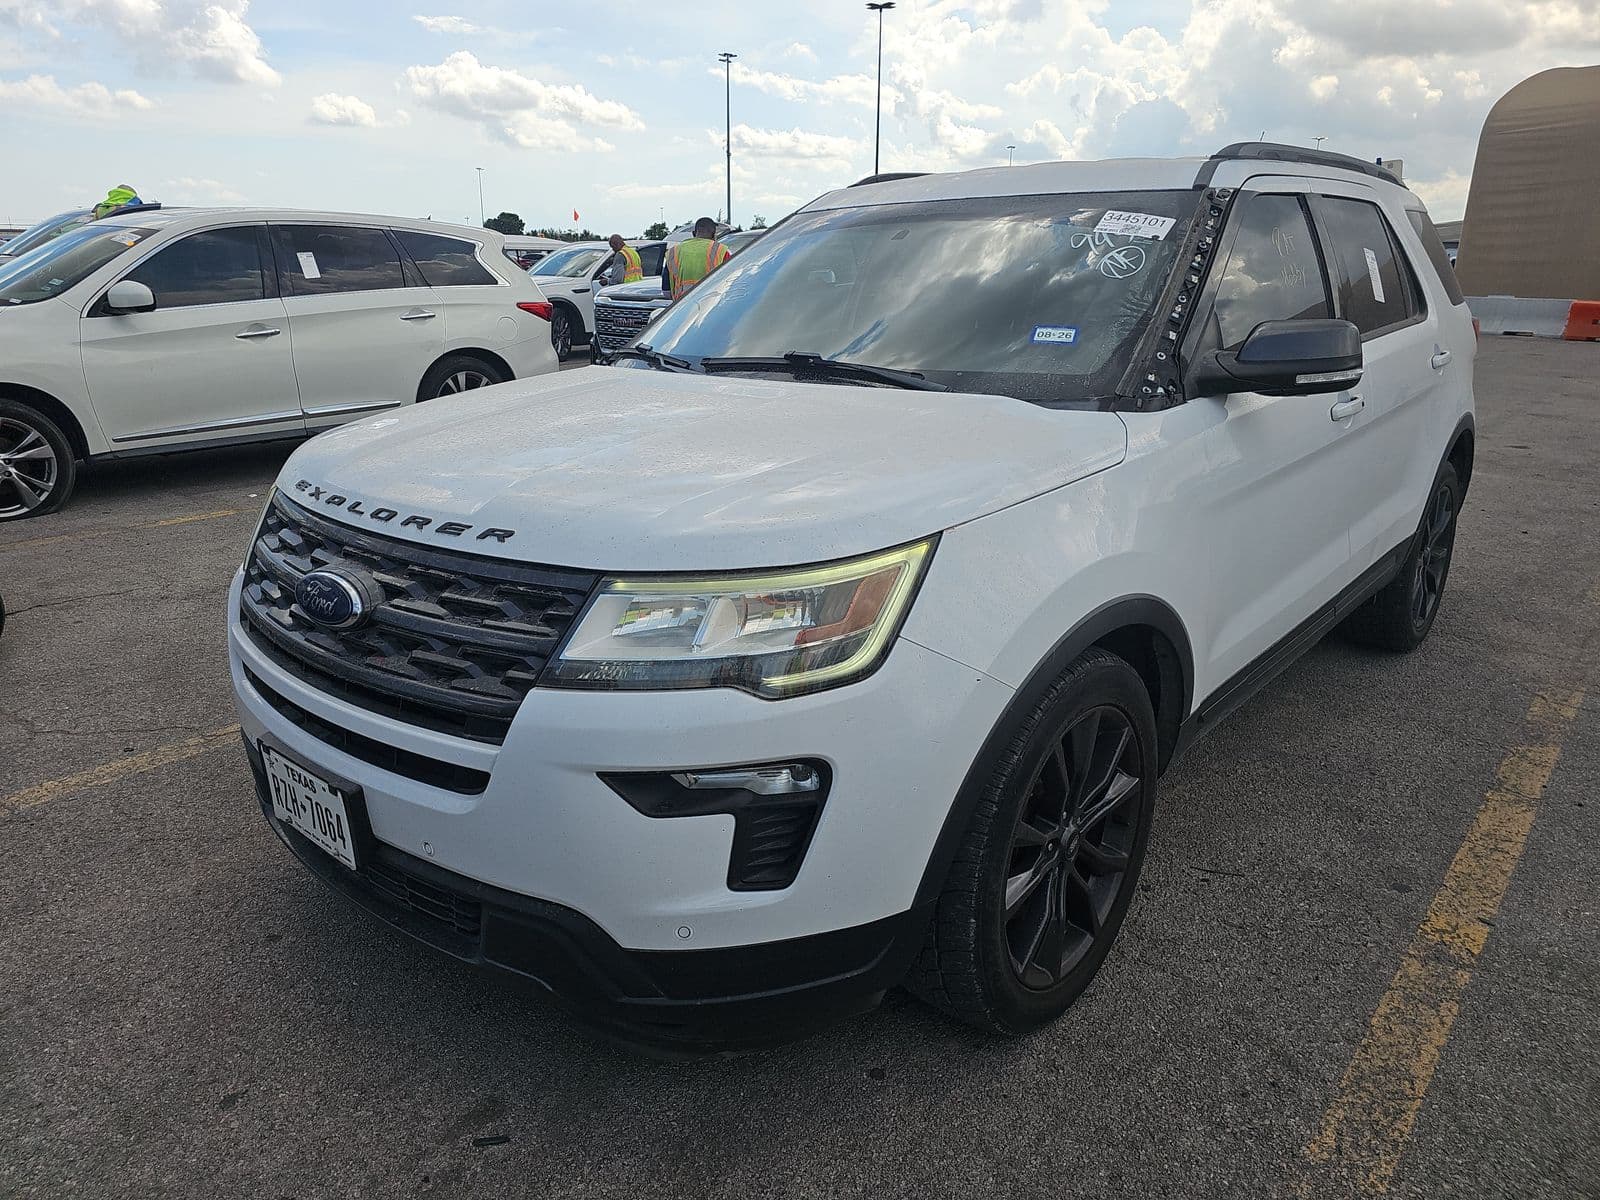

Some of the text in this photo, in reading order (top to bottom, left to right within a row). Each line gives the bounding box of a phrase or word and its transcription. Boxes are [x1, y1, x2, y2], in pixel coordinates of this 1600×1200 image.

[1103, 212, 1167, 228] 3445101
[295, 479, 516, 543] EXPLORER
[302, 580, 338, 616] Ford
[283, 763, 317, 794] TEXAS
